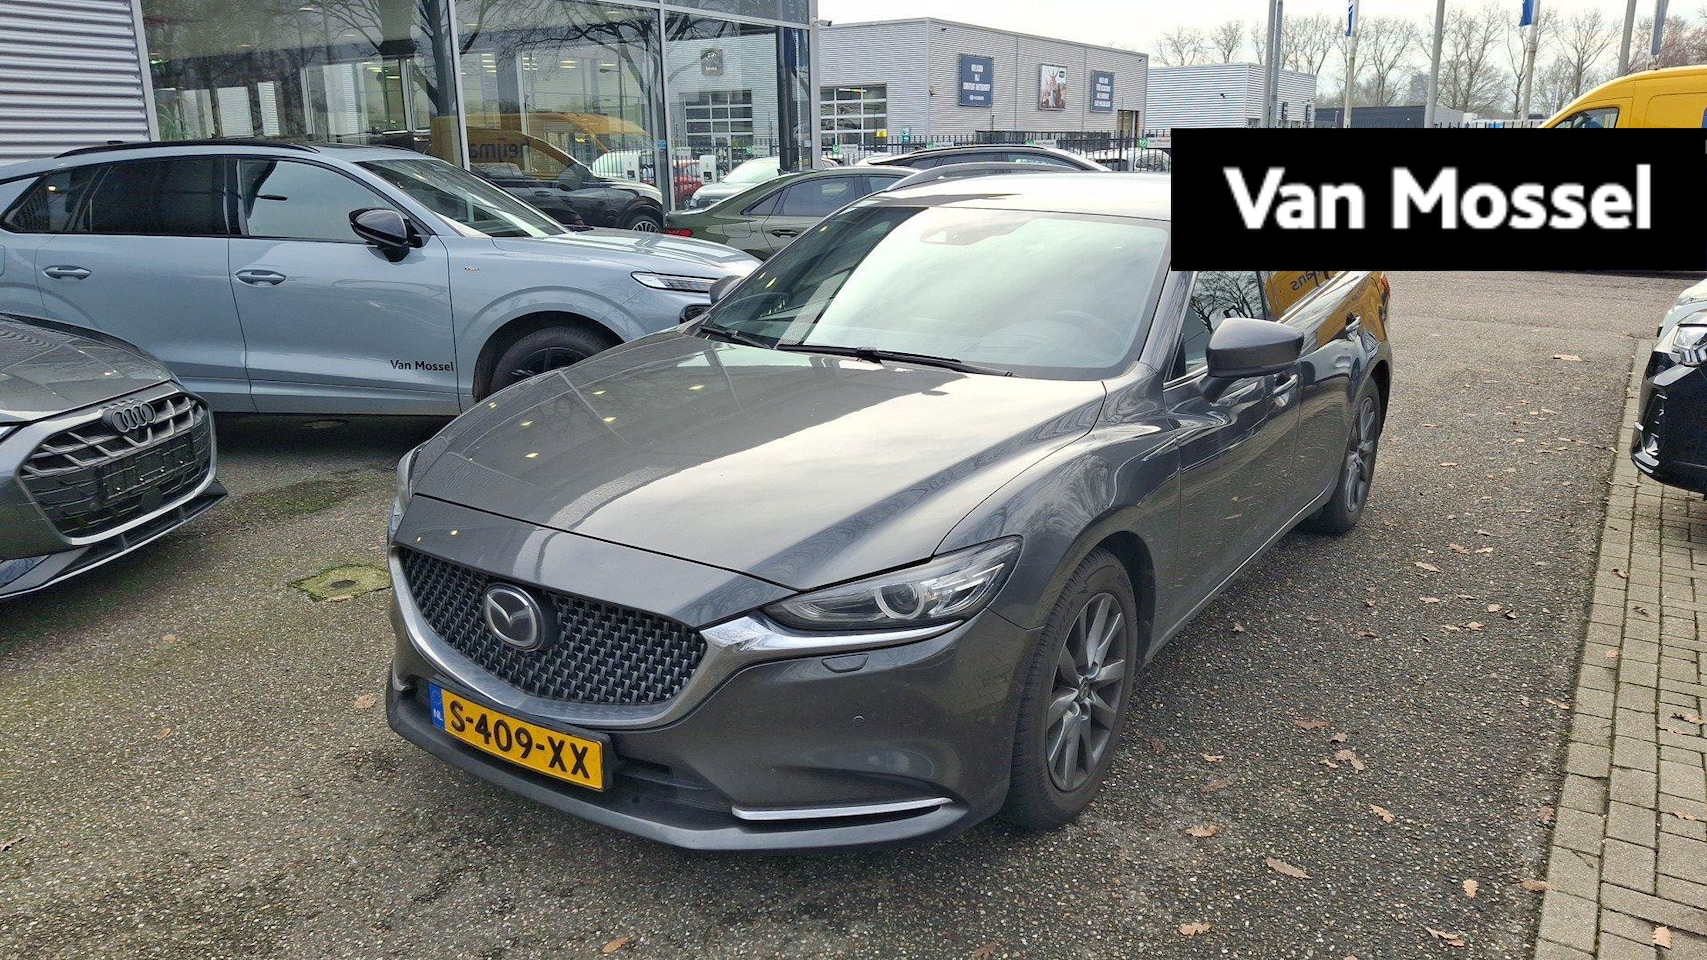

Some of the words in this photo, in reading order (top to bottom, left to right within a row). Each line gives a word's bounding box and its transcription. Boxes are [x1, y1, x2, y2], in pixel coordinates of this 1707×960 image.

[390, 359, 411, 370] Van
[415, 360, 454, 371] Mossel
[432, 708, 444, 722] NL
[449, 700, 590, 779] S-409-XX
